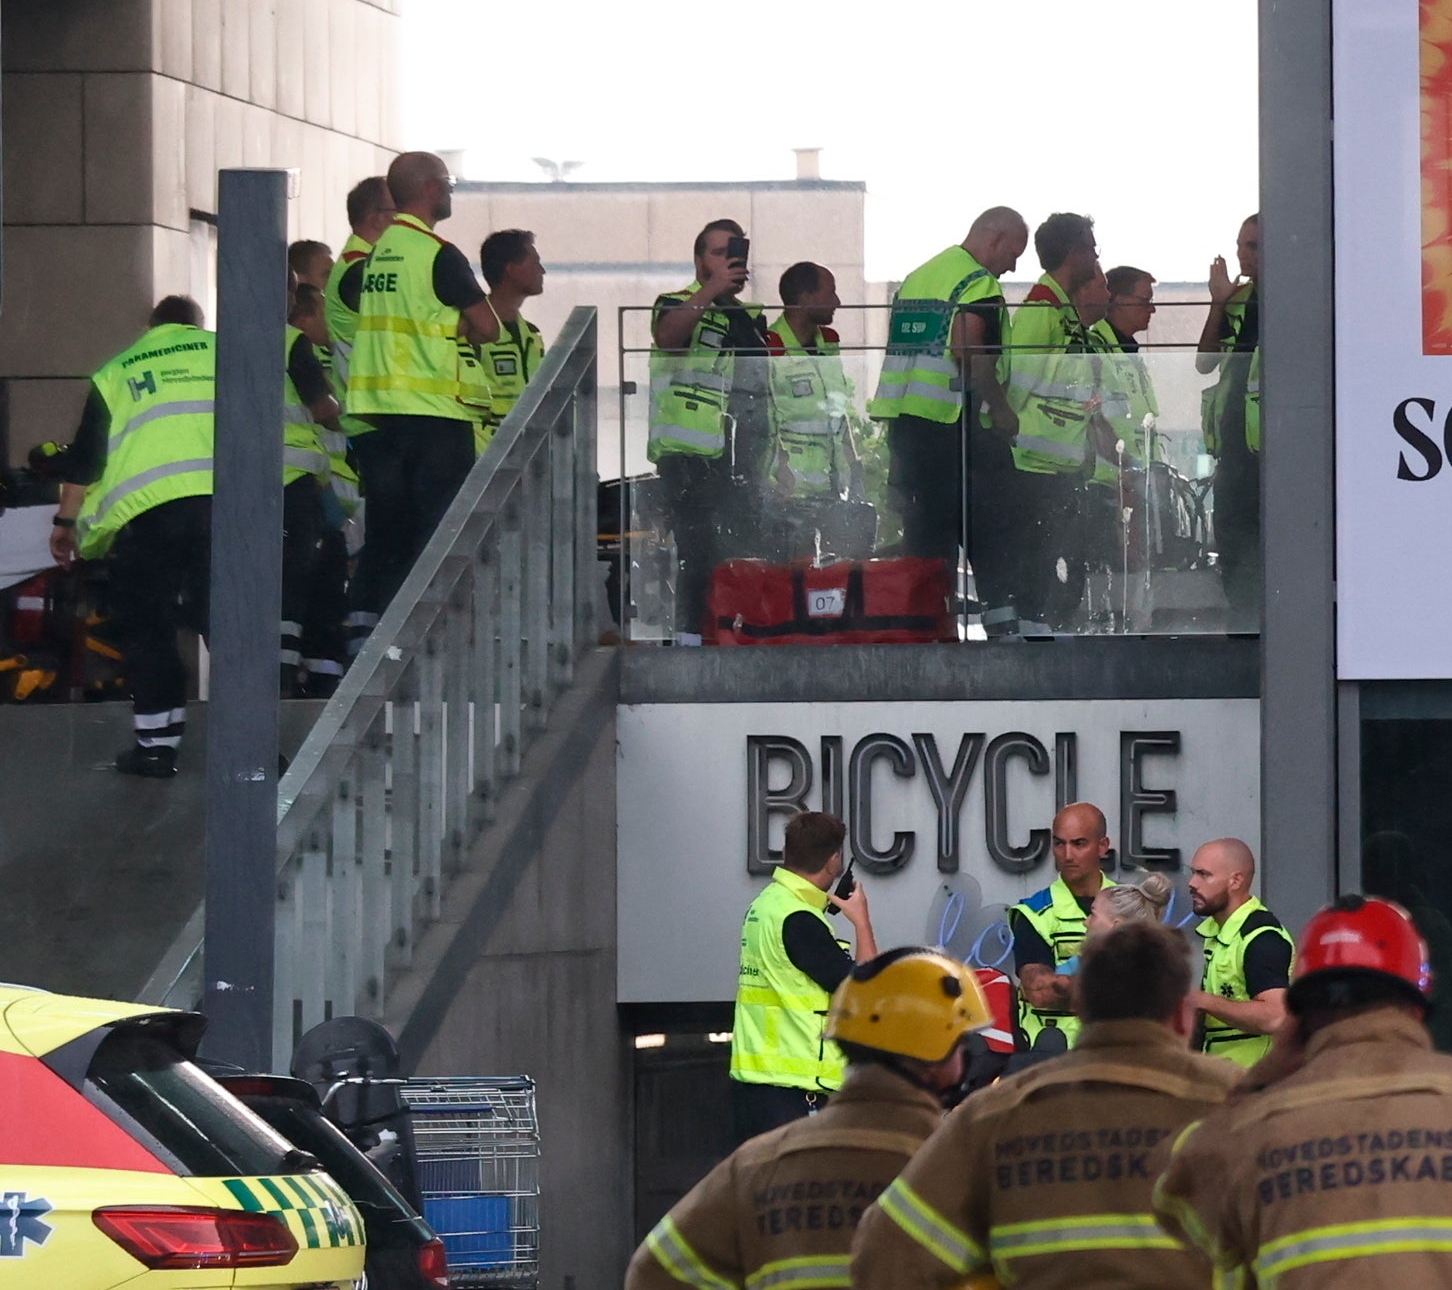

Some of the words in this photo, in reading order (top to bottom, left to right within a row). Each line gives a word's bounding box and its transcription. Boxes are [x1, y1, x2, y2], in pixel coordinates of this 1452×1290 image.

[361, 273, 398, 294] ÆGE
[816, 596, 836, 611] 07
[746, 730, 1181, 875] BICYCLE
[998, 1153, 1150, 1190] BEREDSK
